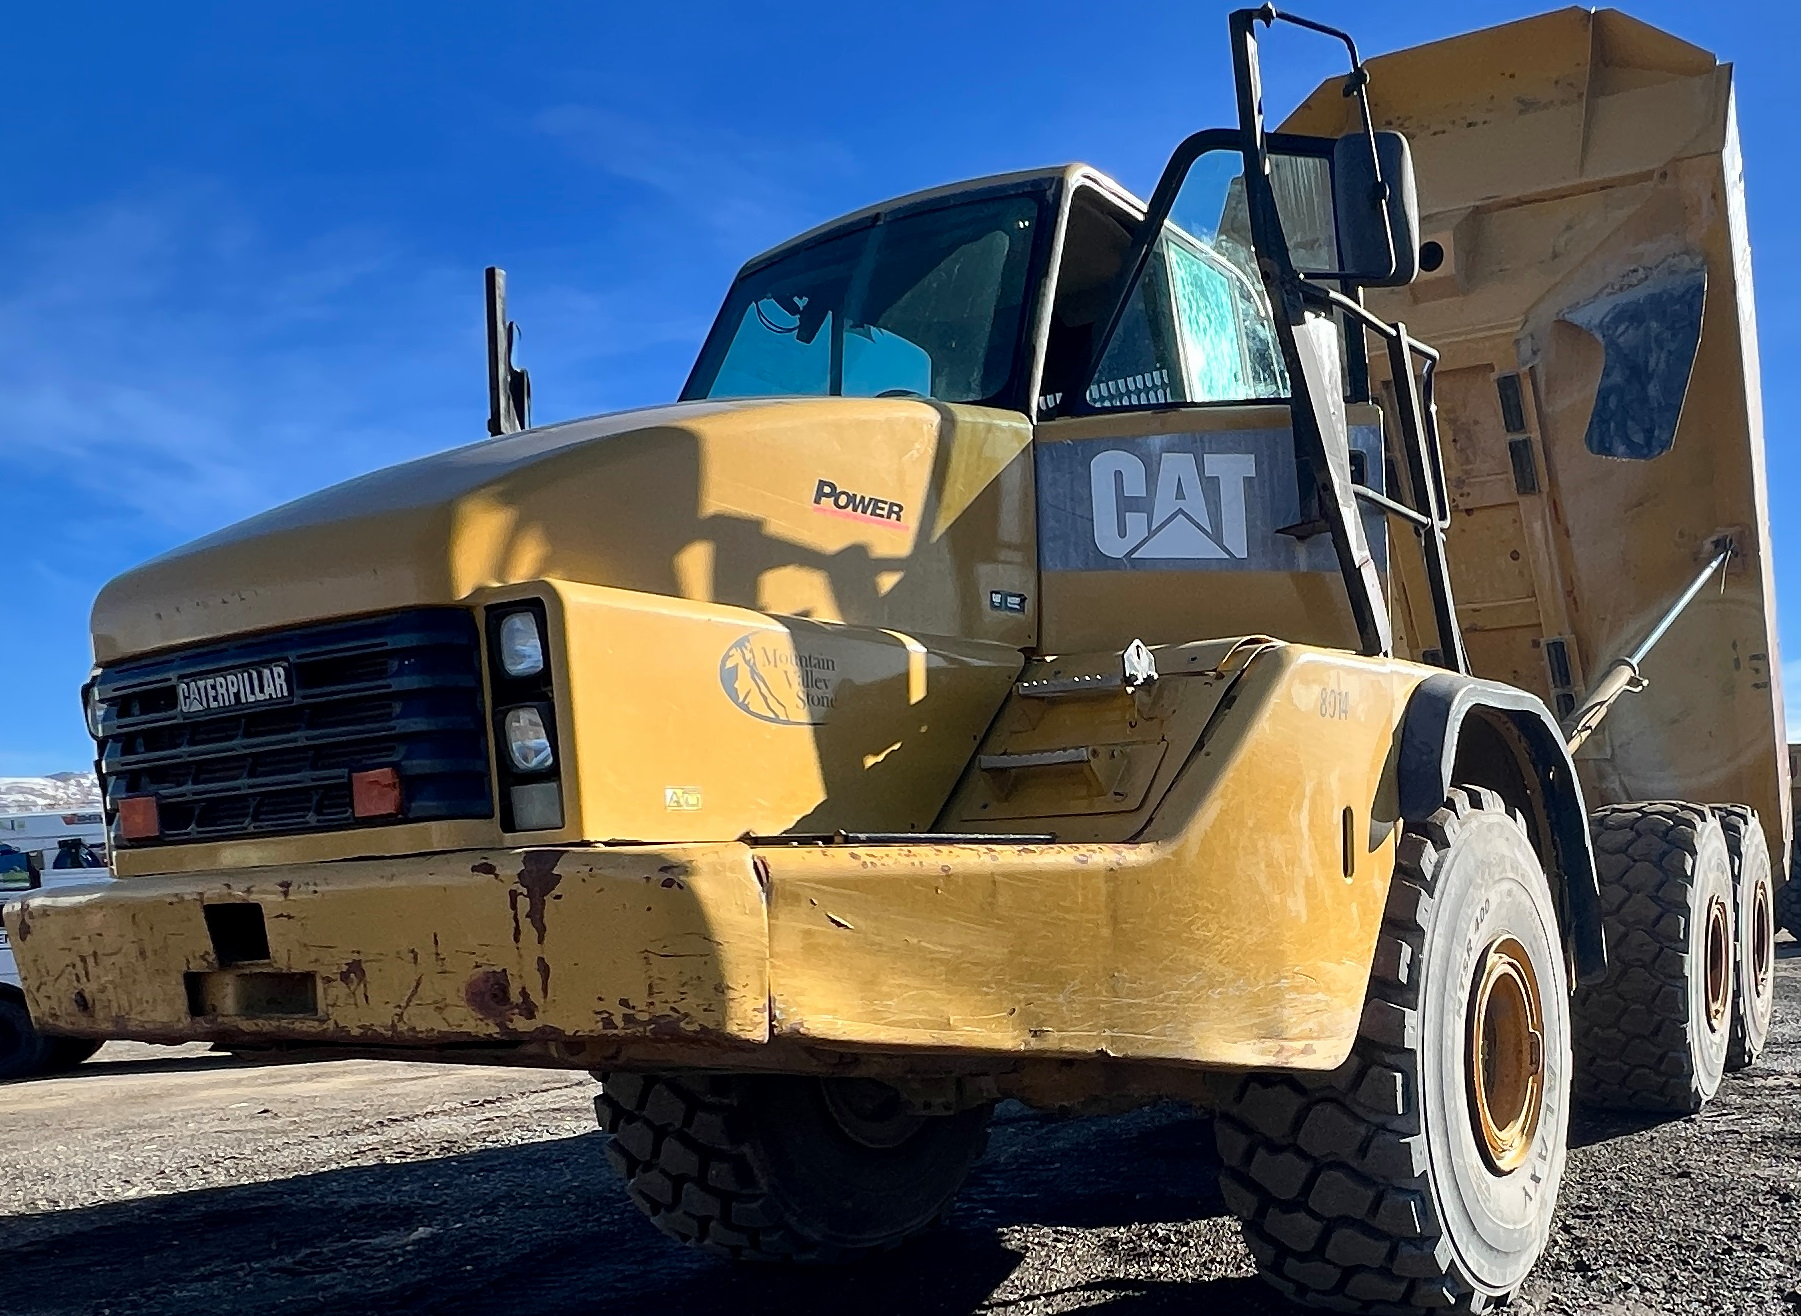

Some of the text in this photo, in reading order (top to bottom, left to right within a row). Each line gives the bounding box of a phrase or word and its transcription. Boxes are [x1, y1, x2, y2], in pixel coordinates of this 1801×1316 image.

[813, 478, 904, 522] POWER
[1090, 450, 1256, 559] CAT
[761, 646, 836, 672] Mountain
[179, 664, 289, 713] CATERPILLAR
[783, 669, 832, 691] Valley
[1320, 687, 1349, 721] 8014
